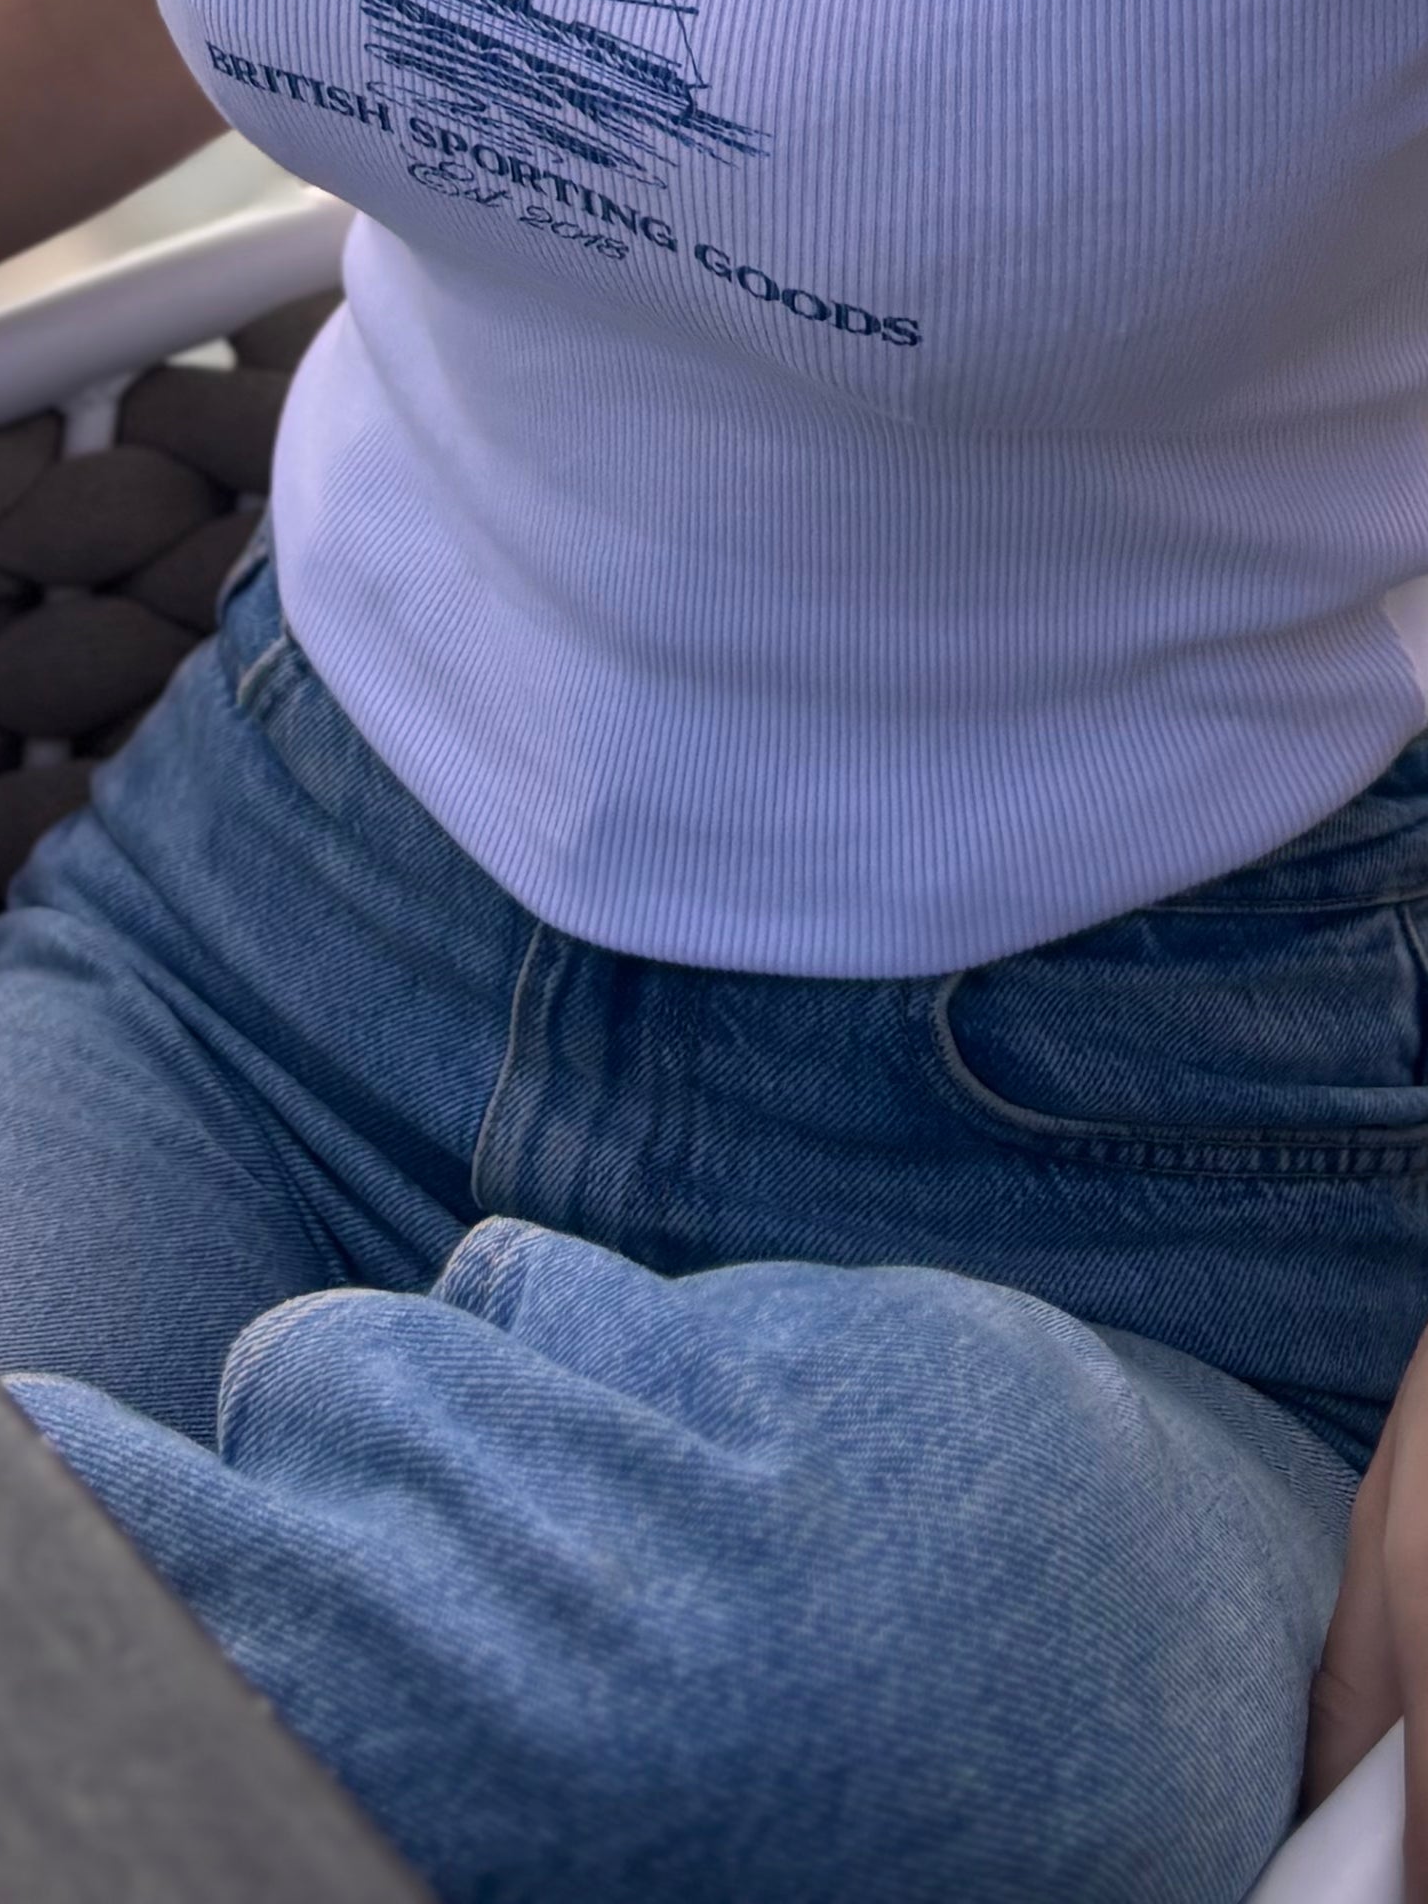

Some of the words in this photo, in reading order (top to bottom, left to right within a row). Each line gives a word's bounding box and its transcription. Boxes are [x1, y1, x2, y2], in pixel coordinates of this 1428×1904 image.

[205, 40, 394, 134] BRITISH
[409, 116, 678, 254] SPORTING
[694, 242, 922, 348] GOODS
[519, 205, 630, 261] 2018
